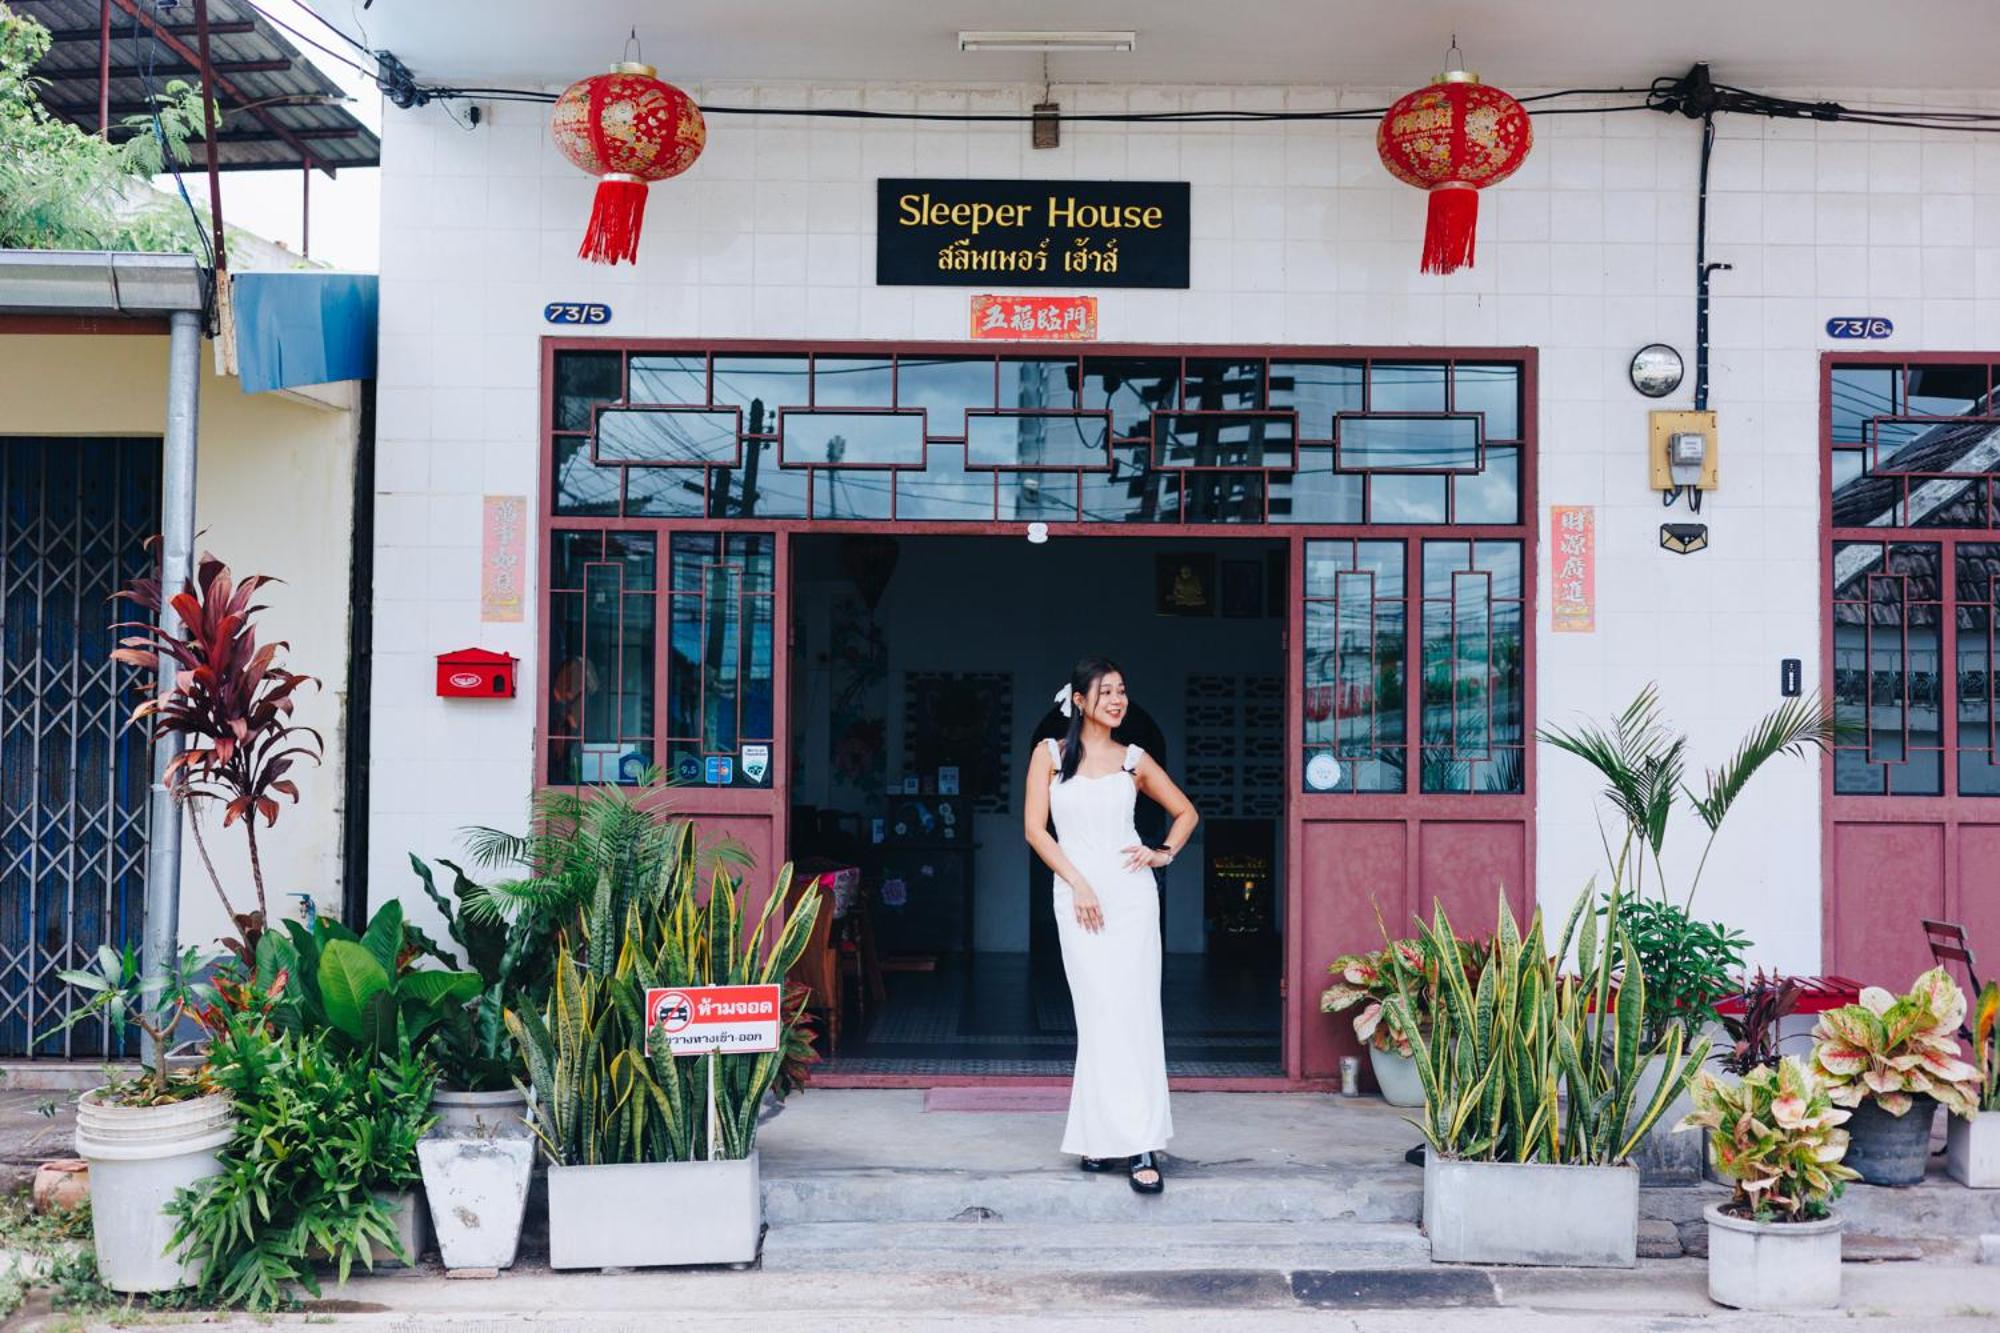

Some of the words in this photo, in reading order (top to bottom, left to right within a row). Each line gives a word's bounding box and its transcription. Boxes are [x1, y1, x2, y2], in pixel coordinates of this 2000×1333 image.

[899, 193, 1032, 235] Sleeper
[1048, 196, 1163, 229] House
[938, 238, 1050, 272] สลีพเพอร์
[1064, 237, 1119, 273] เฮ้าส์
[549, 305, 606, 323] 73/5
[982, 304, 1087, 332] 五福臨門
[1833, 319, 1886, 337] 73/6
[697, 997, 773, 1016] ห้ามจอด
